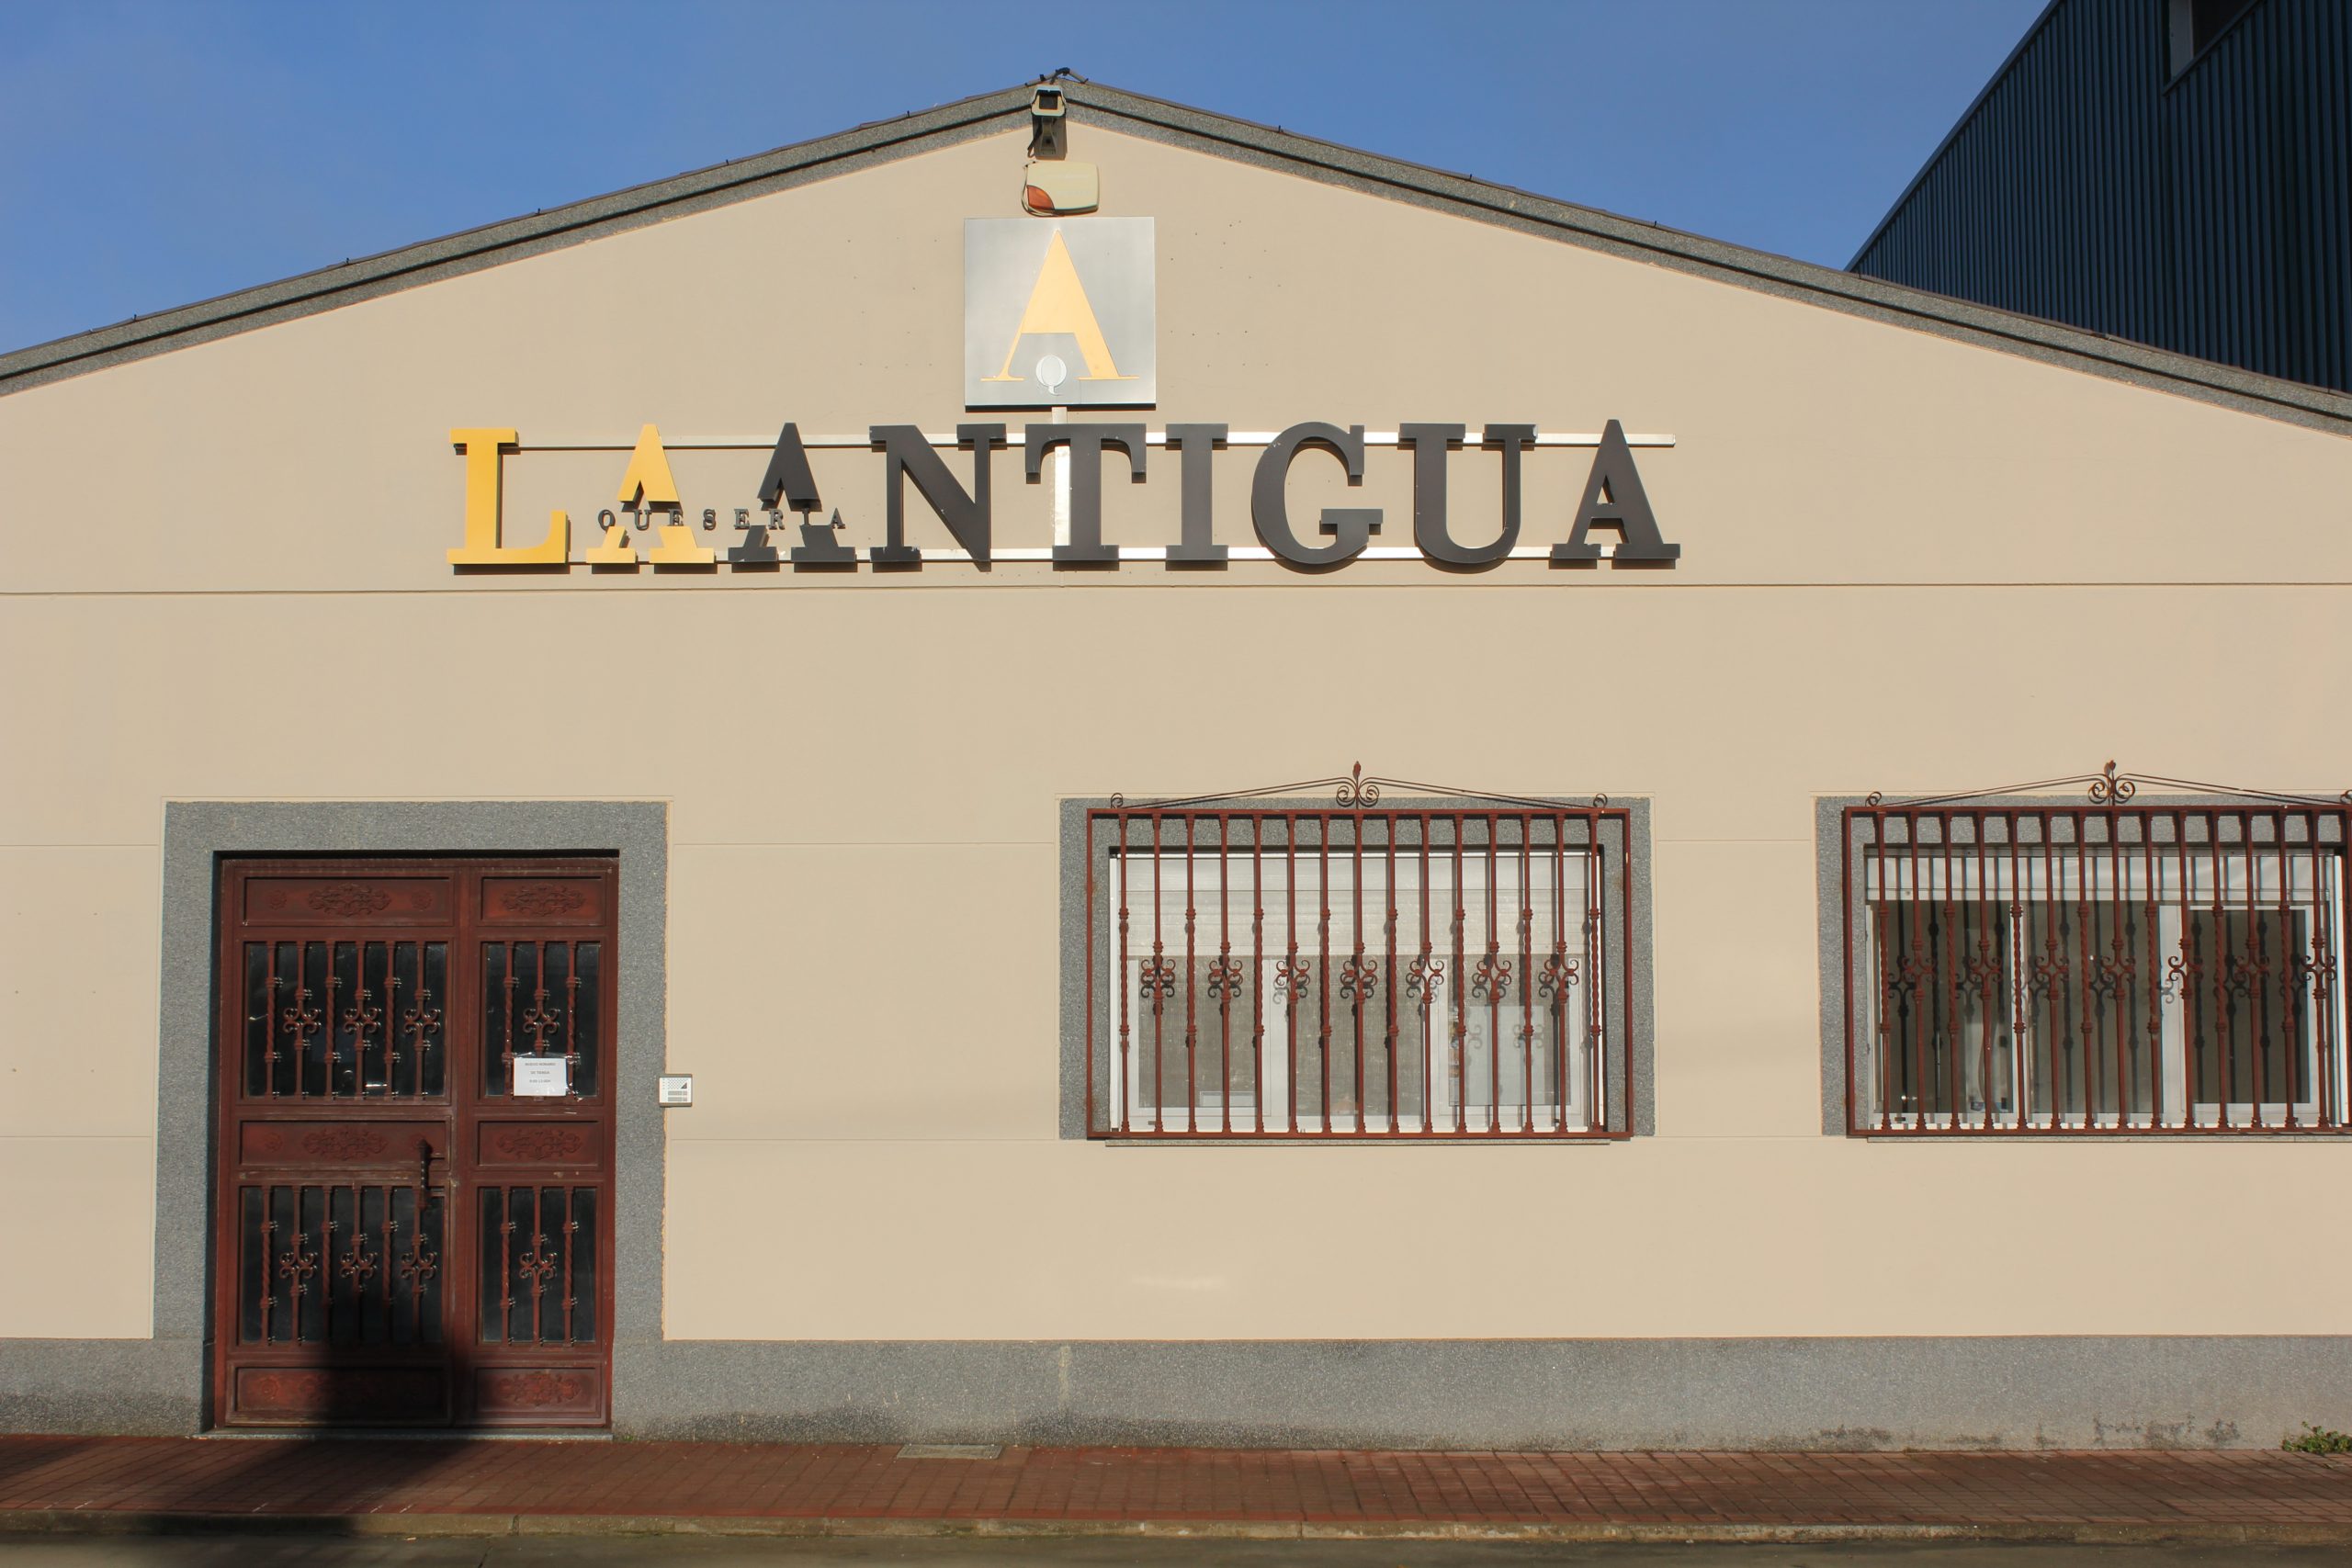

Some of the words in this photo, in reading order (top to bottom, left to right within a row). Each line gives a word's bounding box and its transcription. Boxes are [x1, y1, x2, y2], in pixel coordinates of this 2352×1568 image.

[979, 228, 1140, 382] A
[1035, 354, 1068, 396] Q
[447, 423, 717, 567] LA
[728, 419, 1680, 568] ANTIGUA
[597, 507, 846, 531] QUESERIA
